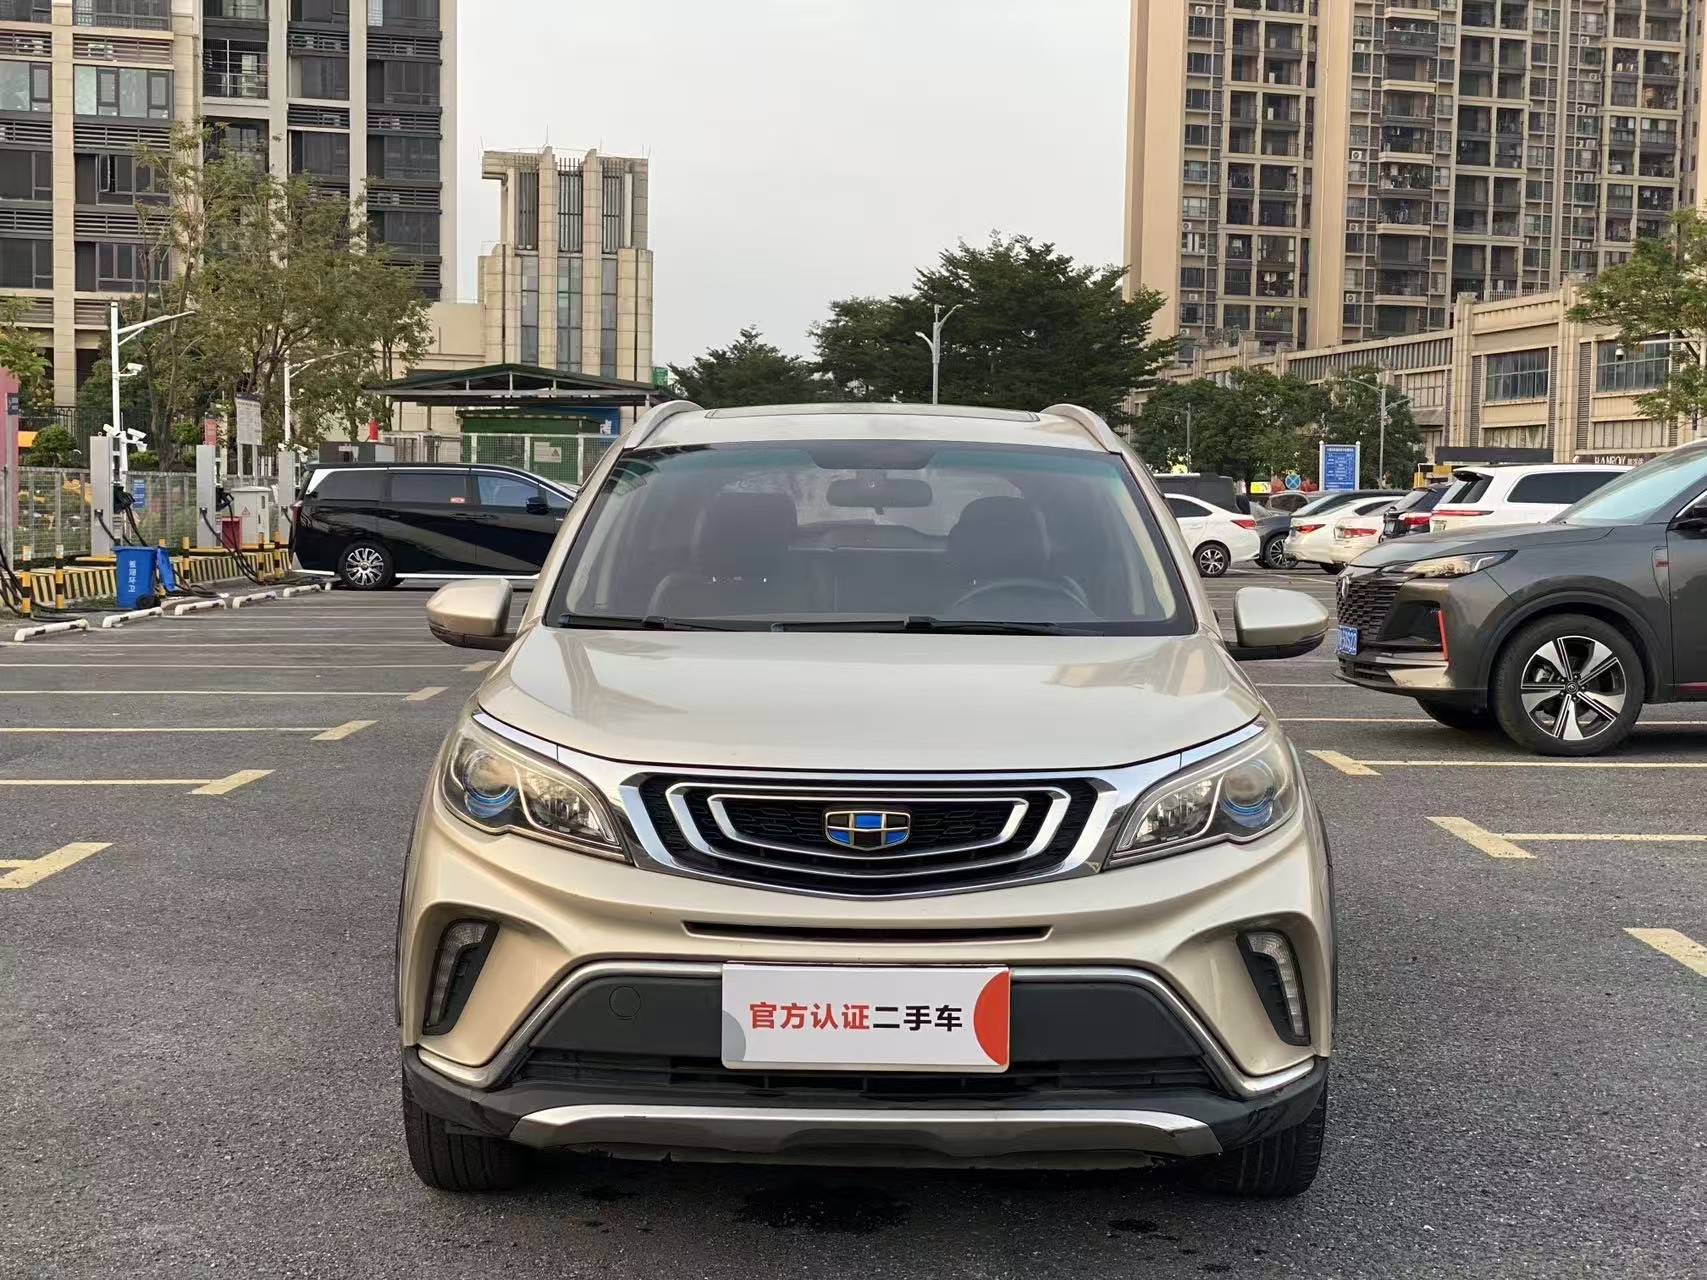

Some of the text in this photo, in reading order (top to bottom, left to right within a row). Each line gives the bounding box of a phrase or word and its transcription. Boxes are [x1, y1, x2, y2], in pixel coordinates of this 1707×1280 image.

[750, 1002, 963, 1032] 官方认证二手车
